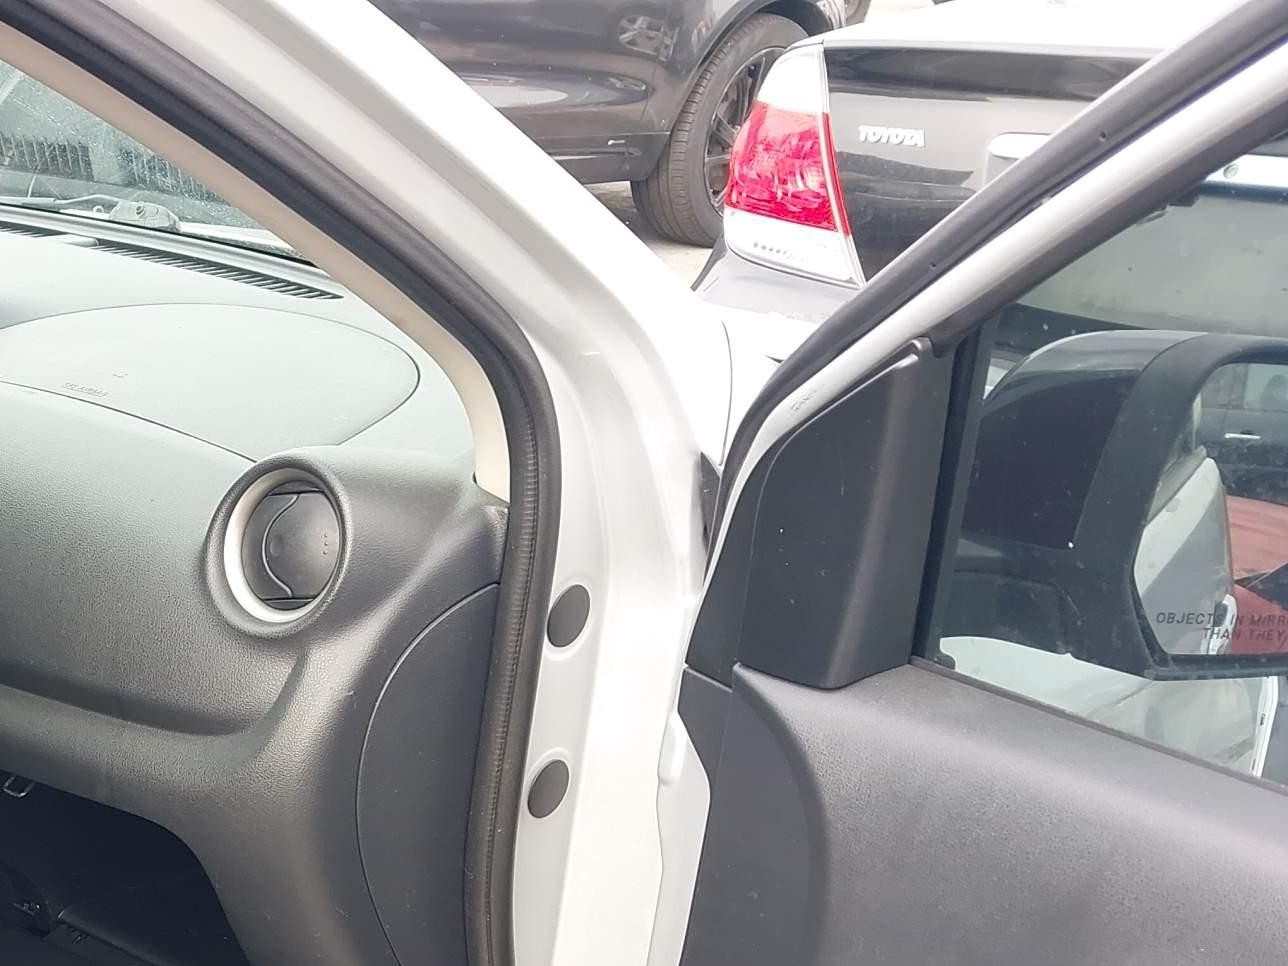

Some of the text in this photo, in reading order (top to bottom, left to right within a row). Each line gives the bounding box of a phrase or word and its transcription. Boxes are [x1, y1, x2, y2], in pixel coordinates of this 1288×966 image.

[858, 124, 925, 148] TOYOTA
[1156, 611, 1227, 626] OBJECTS
[1249, 613, 1288, 627] MIRR
[1205, 627, 1286, 641] THAN THEY
